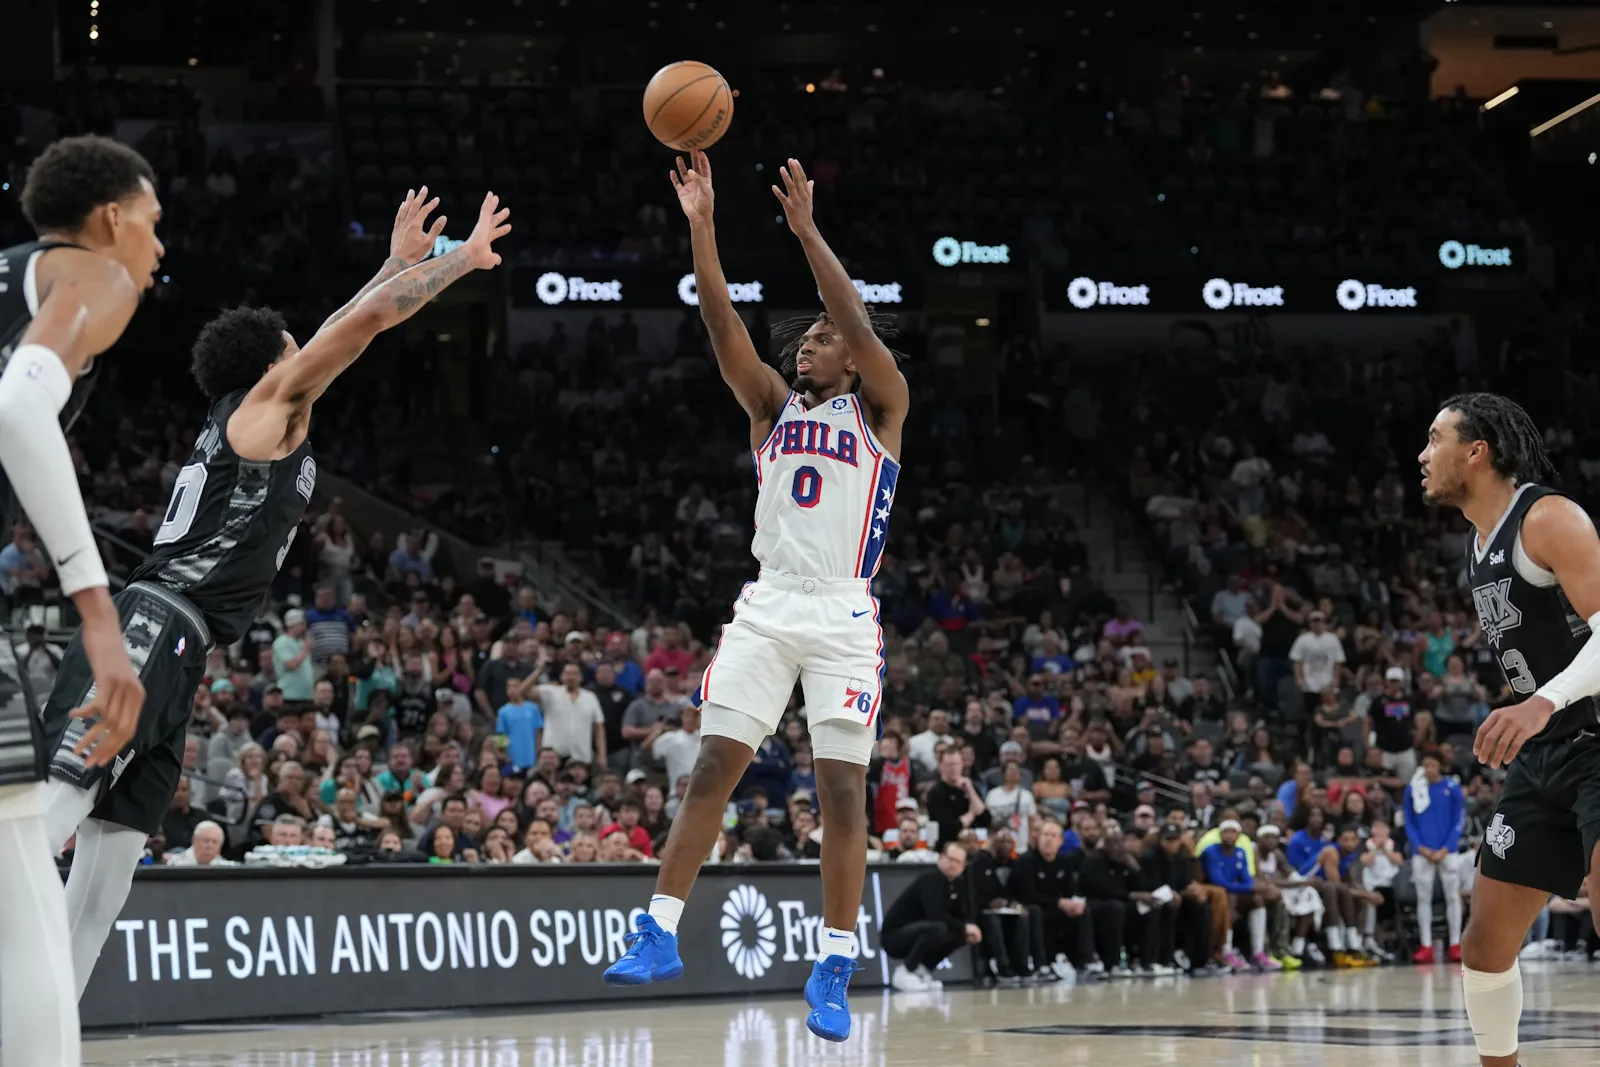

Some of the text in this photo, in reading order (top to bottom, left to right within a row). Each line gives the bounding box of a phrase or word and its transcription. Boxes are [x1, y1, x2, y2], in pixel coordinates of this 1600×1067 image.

[961, 240, 1010, 264] Frost
[1466, 244, 1511, 266] Frost
[568, 276, 623, 302] Frost
[1097, 281, 1150, 306] Frost
[1233, 282, 1285, 307] Frost
[1366, 283, 1418, 308] Frost
[769, 420, 858, 468] PHILA
[791, 465, 823, 508] 0
[843, 686, 872, 713] 76
[115, 917, 213, 982] THE
[224, 915, 317, 980] SAN
[330, 909, 519, 974] ANTONIO
